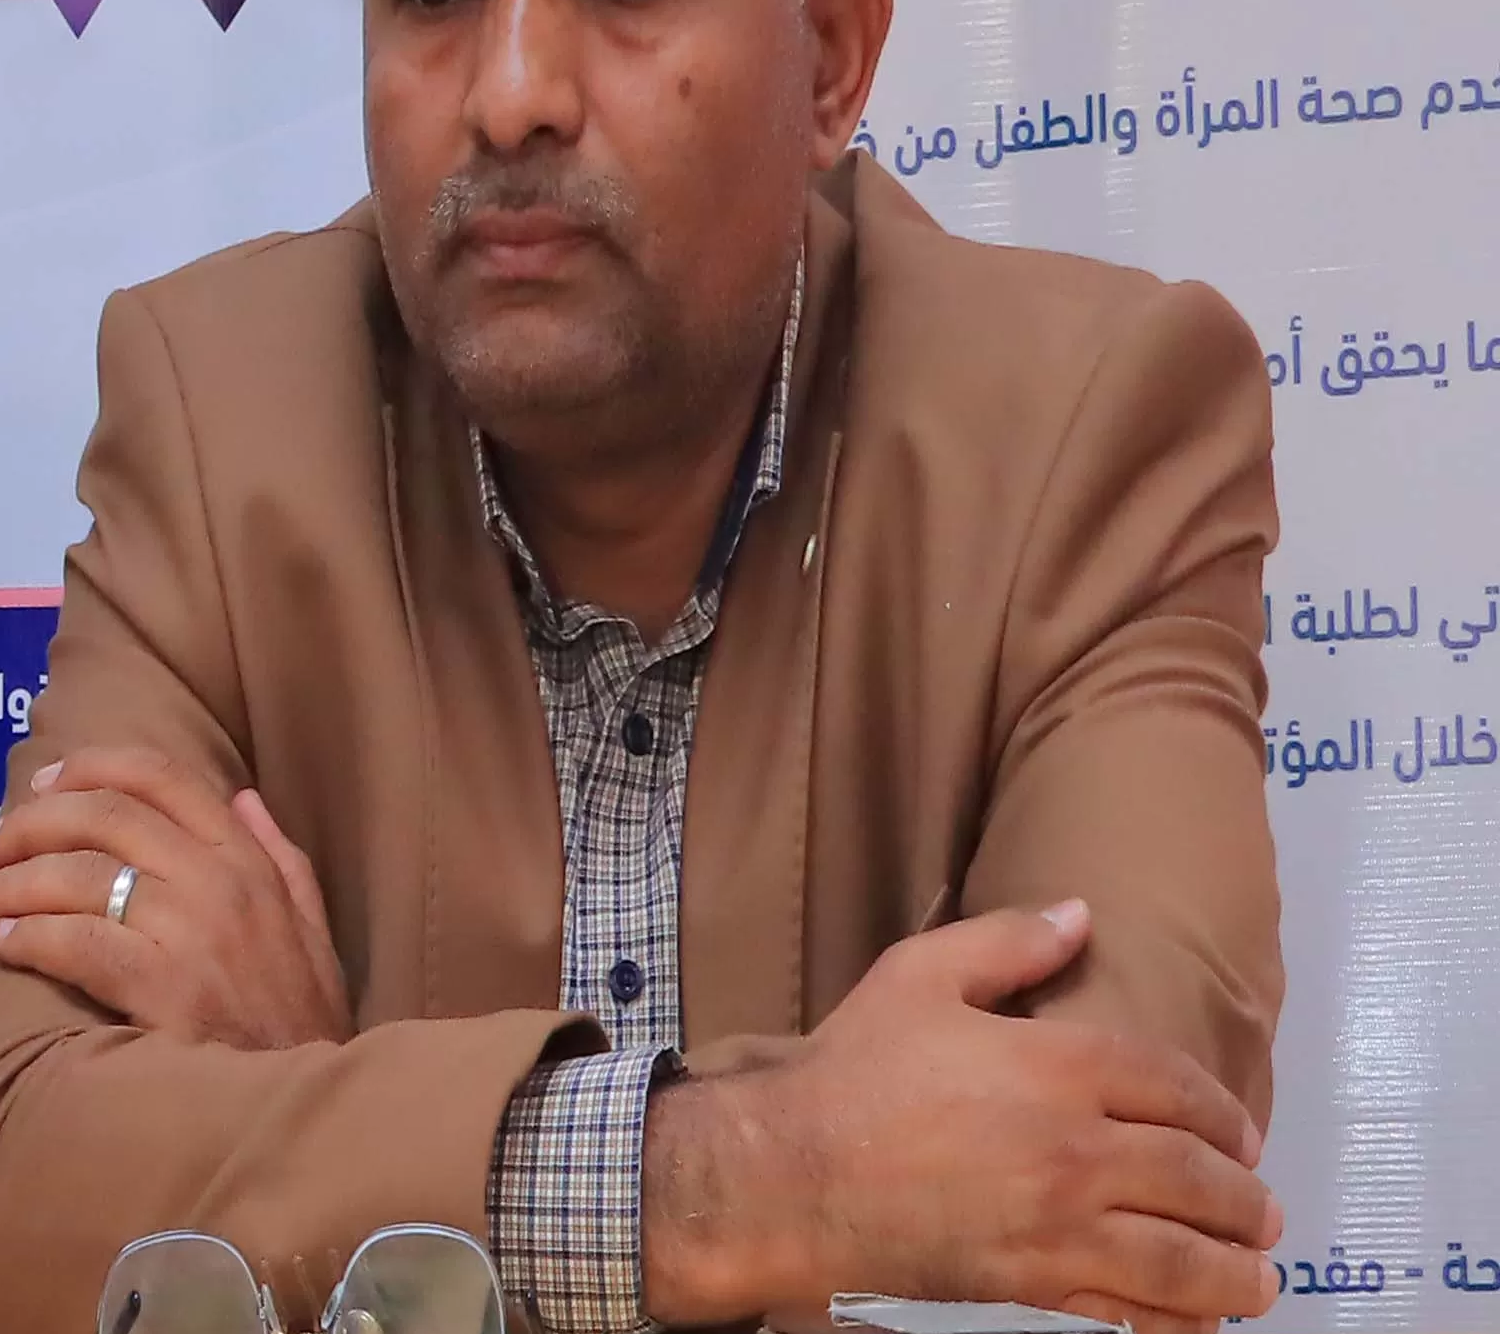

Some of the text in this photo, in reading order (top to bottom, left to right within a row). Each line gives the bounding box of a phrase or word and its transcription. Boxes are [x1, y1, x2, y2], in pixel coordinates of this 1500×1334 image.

[973, 92, 1138, 170] والطفل
[1154, 67, 1279, 149] المرأة
[1297, 75, 1403, 127] صحة
[894, 122, 959, 175] من
[1319, 328, 1448, 398] يحقق
[1290, 586, 1419, 656] لطلبة
[1391, 713, 1499, 784] خلال
